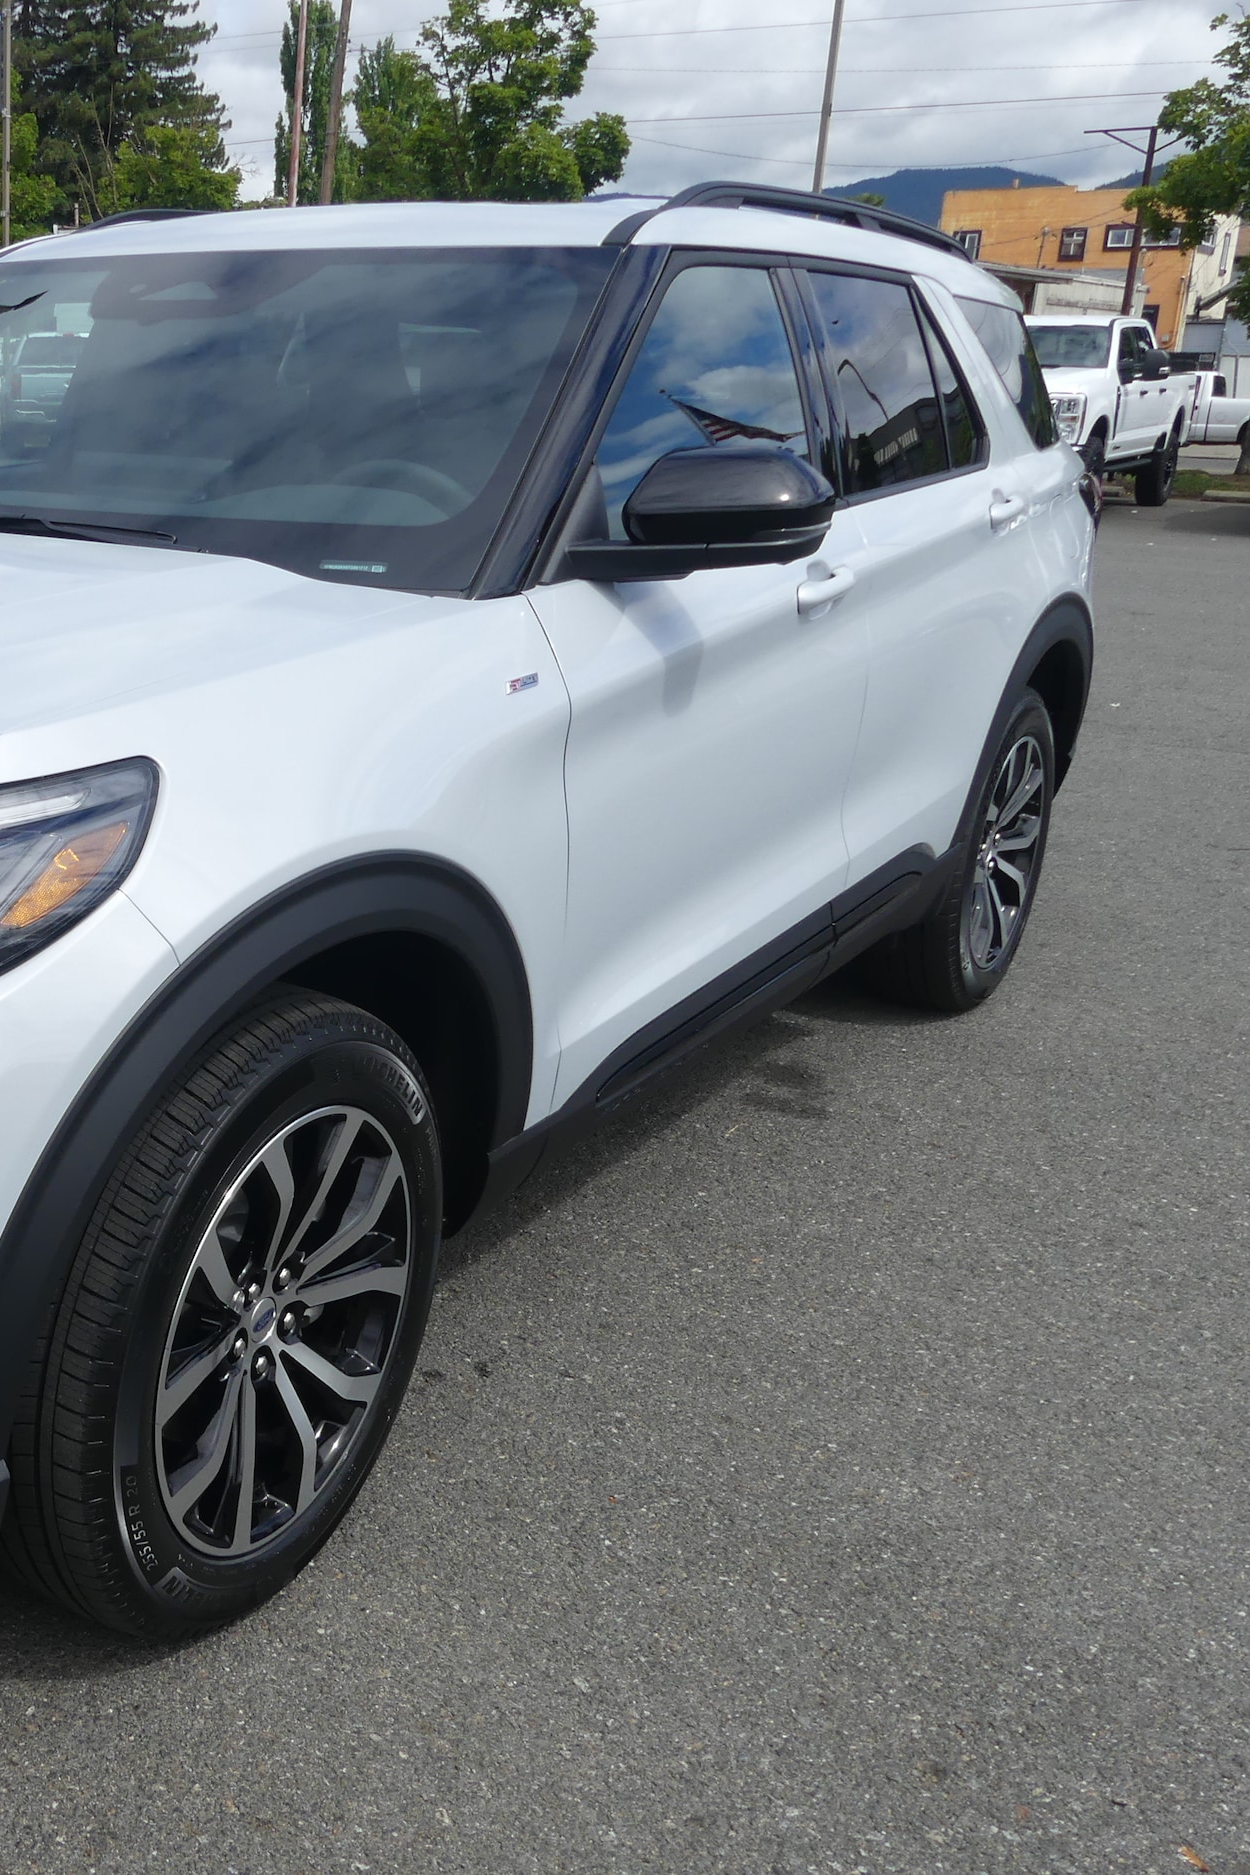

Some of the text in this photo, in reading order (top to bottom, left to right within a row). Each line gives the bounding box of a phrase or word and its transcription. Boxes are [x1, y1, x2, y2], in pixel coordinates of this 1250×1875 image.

[125, 1475, 159, 1573] 255/55 R 20
